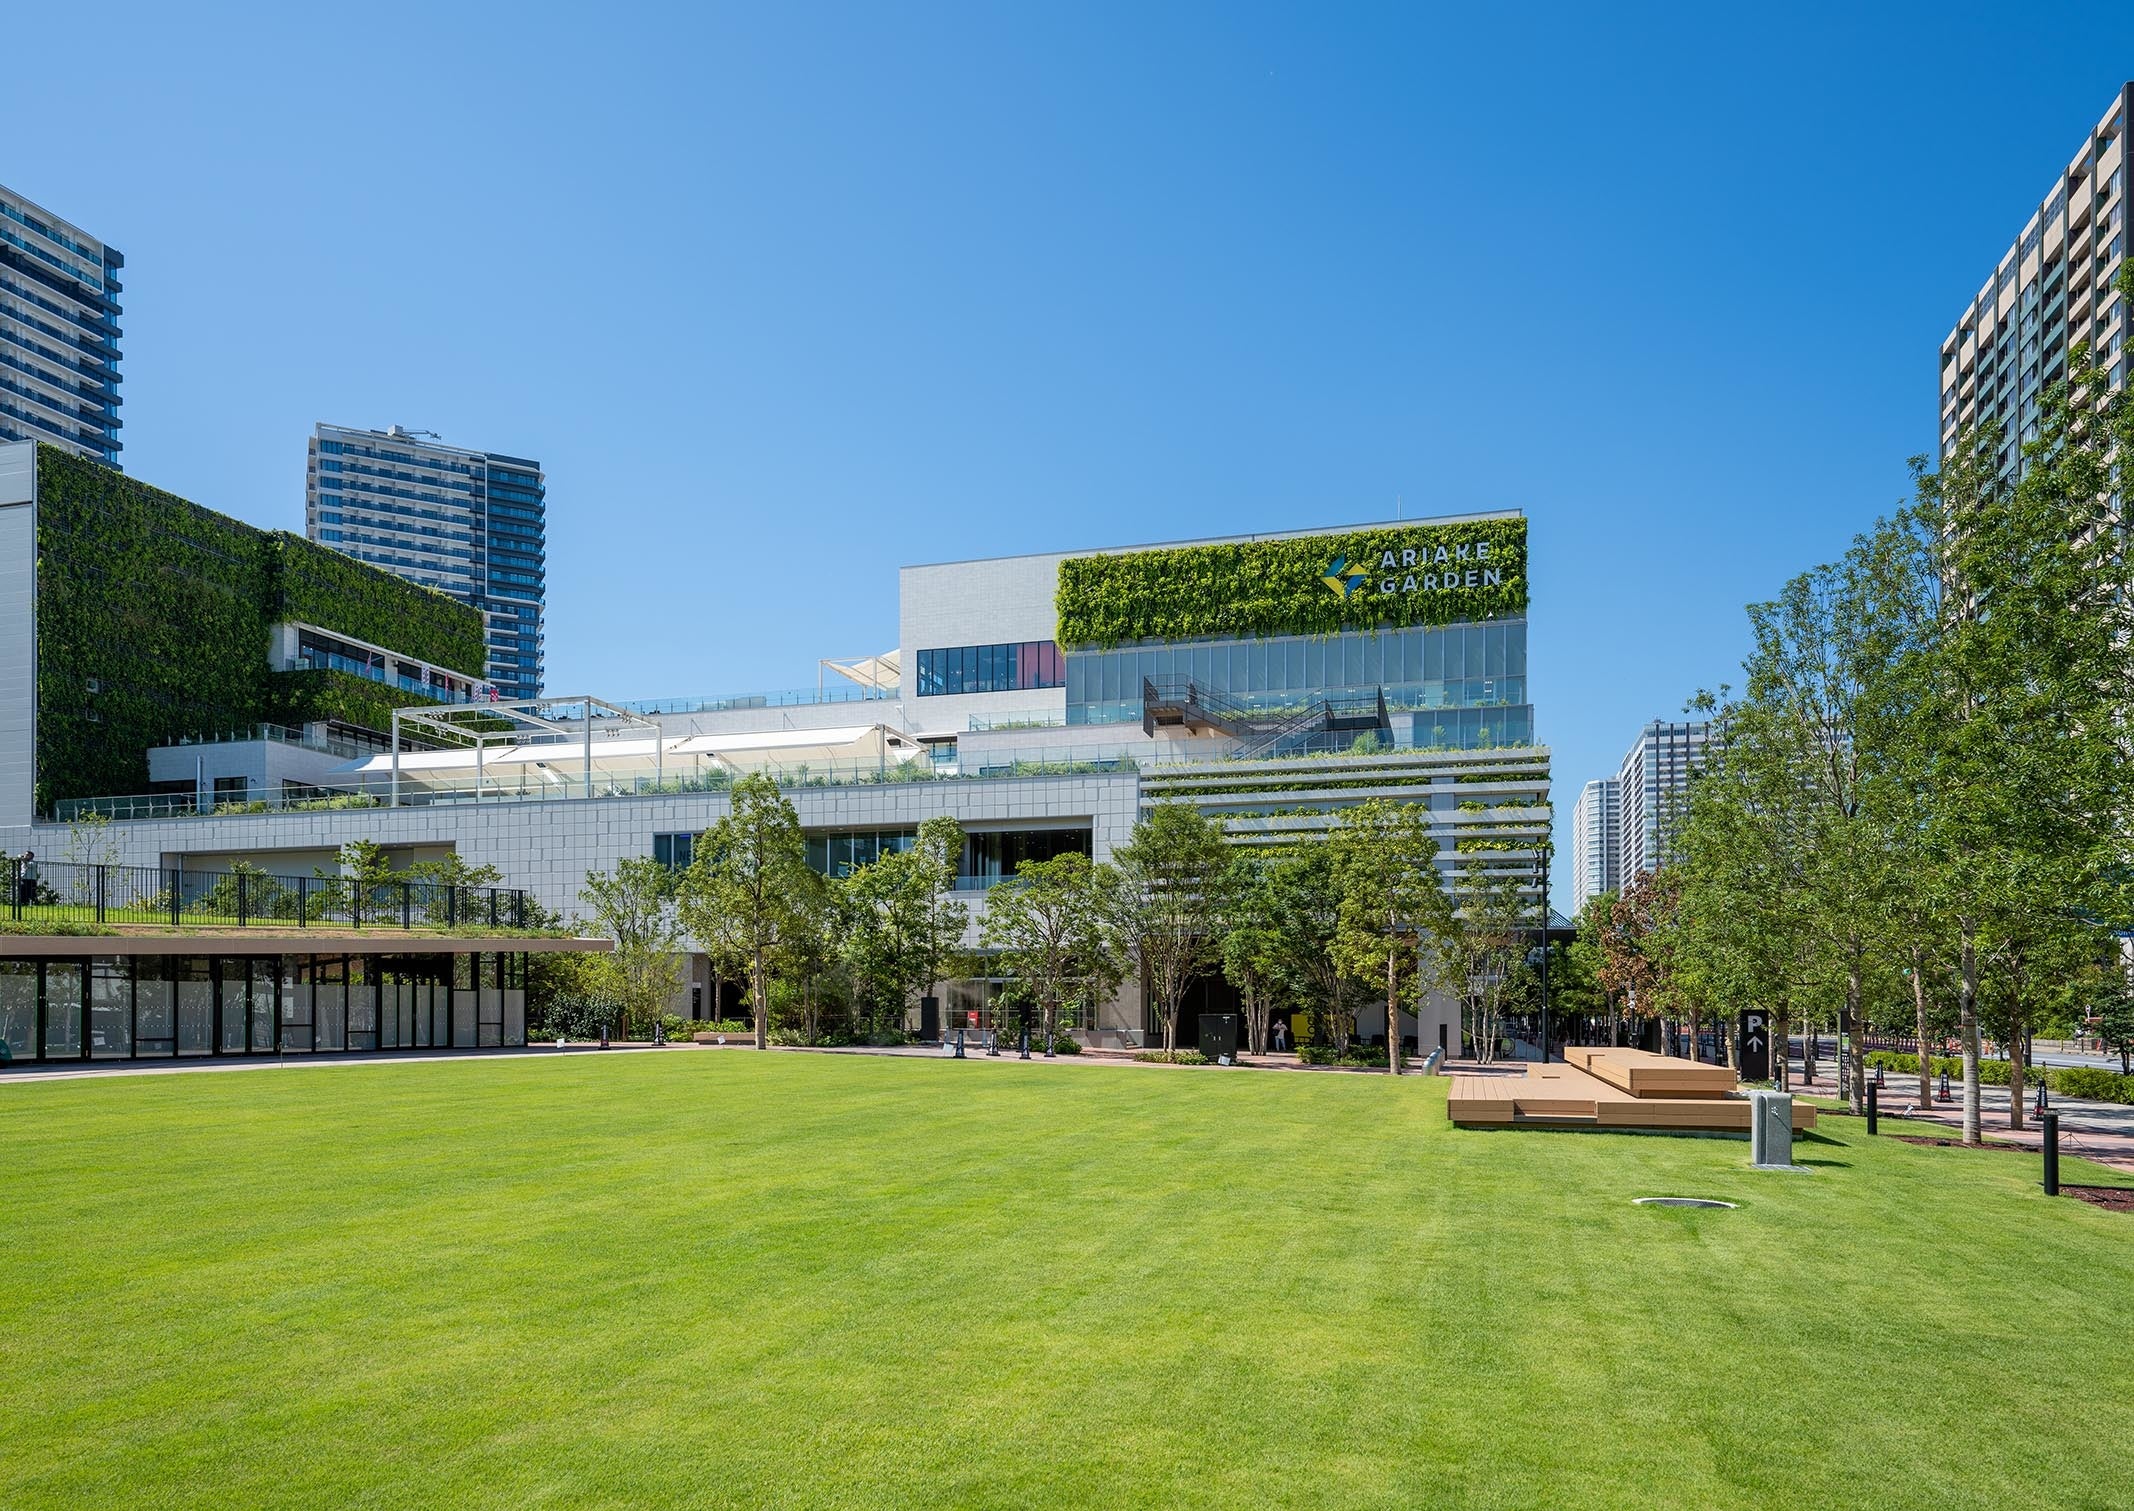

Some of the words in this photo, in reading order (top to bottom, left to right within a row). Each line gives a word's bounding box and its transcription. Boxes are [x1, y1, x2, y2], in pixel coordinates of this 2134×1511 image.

[1380, 542, 1490, 568] ARIAKE
[1380, 567, 1501, 593] GARDEN
[1747, 1015, 1763, 1032] P
